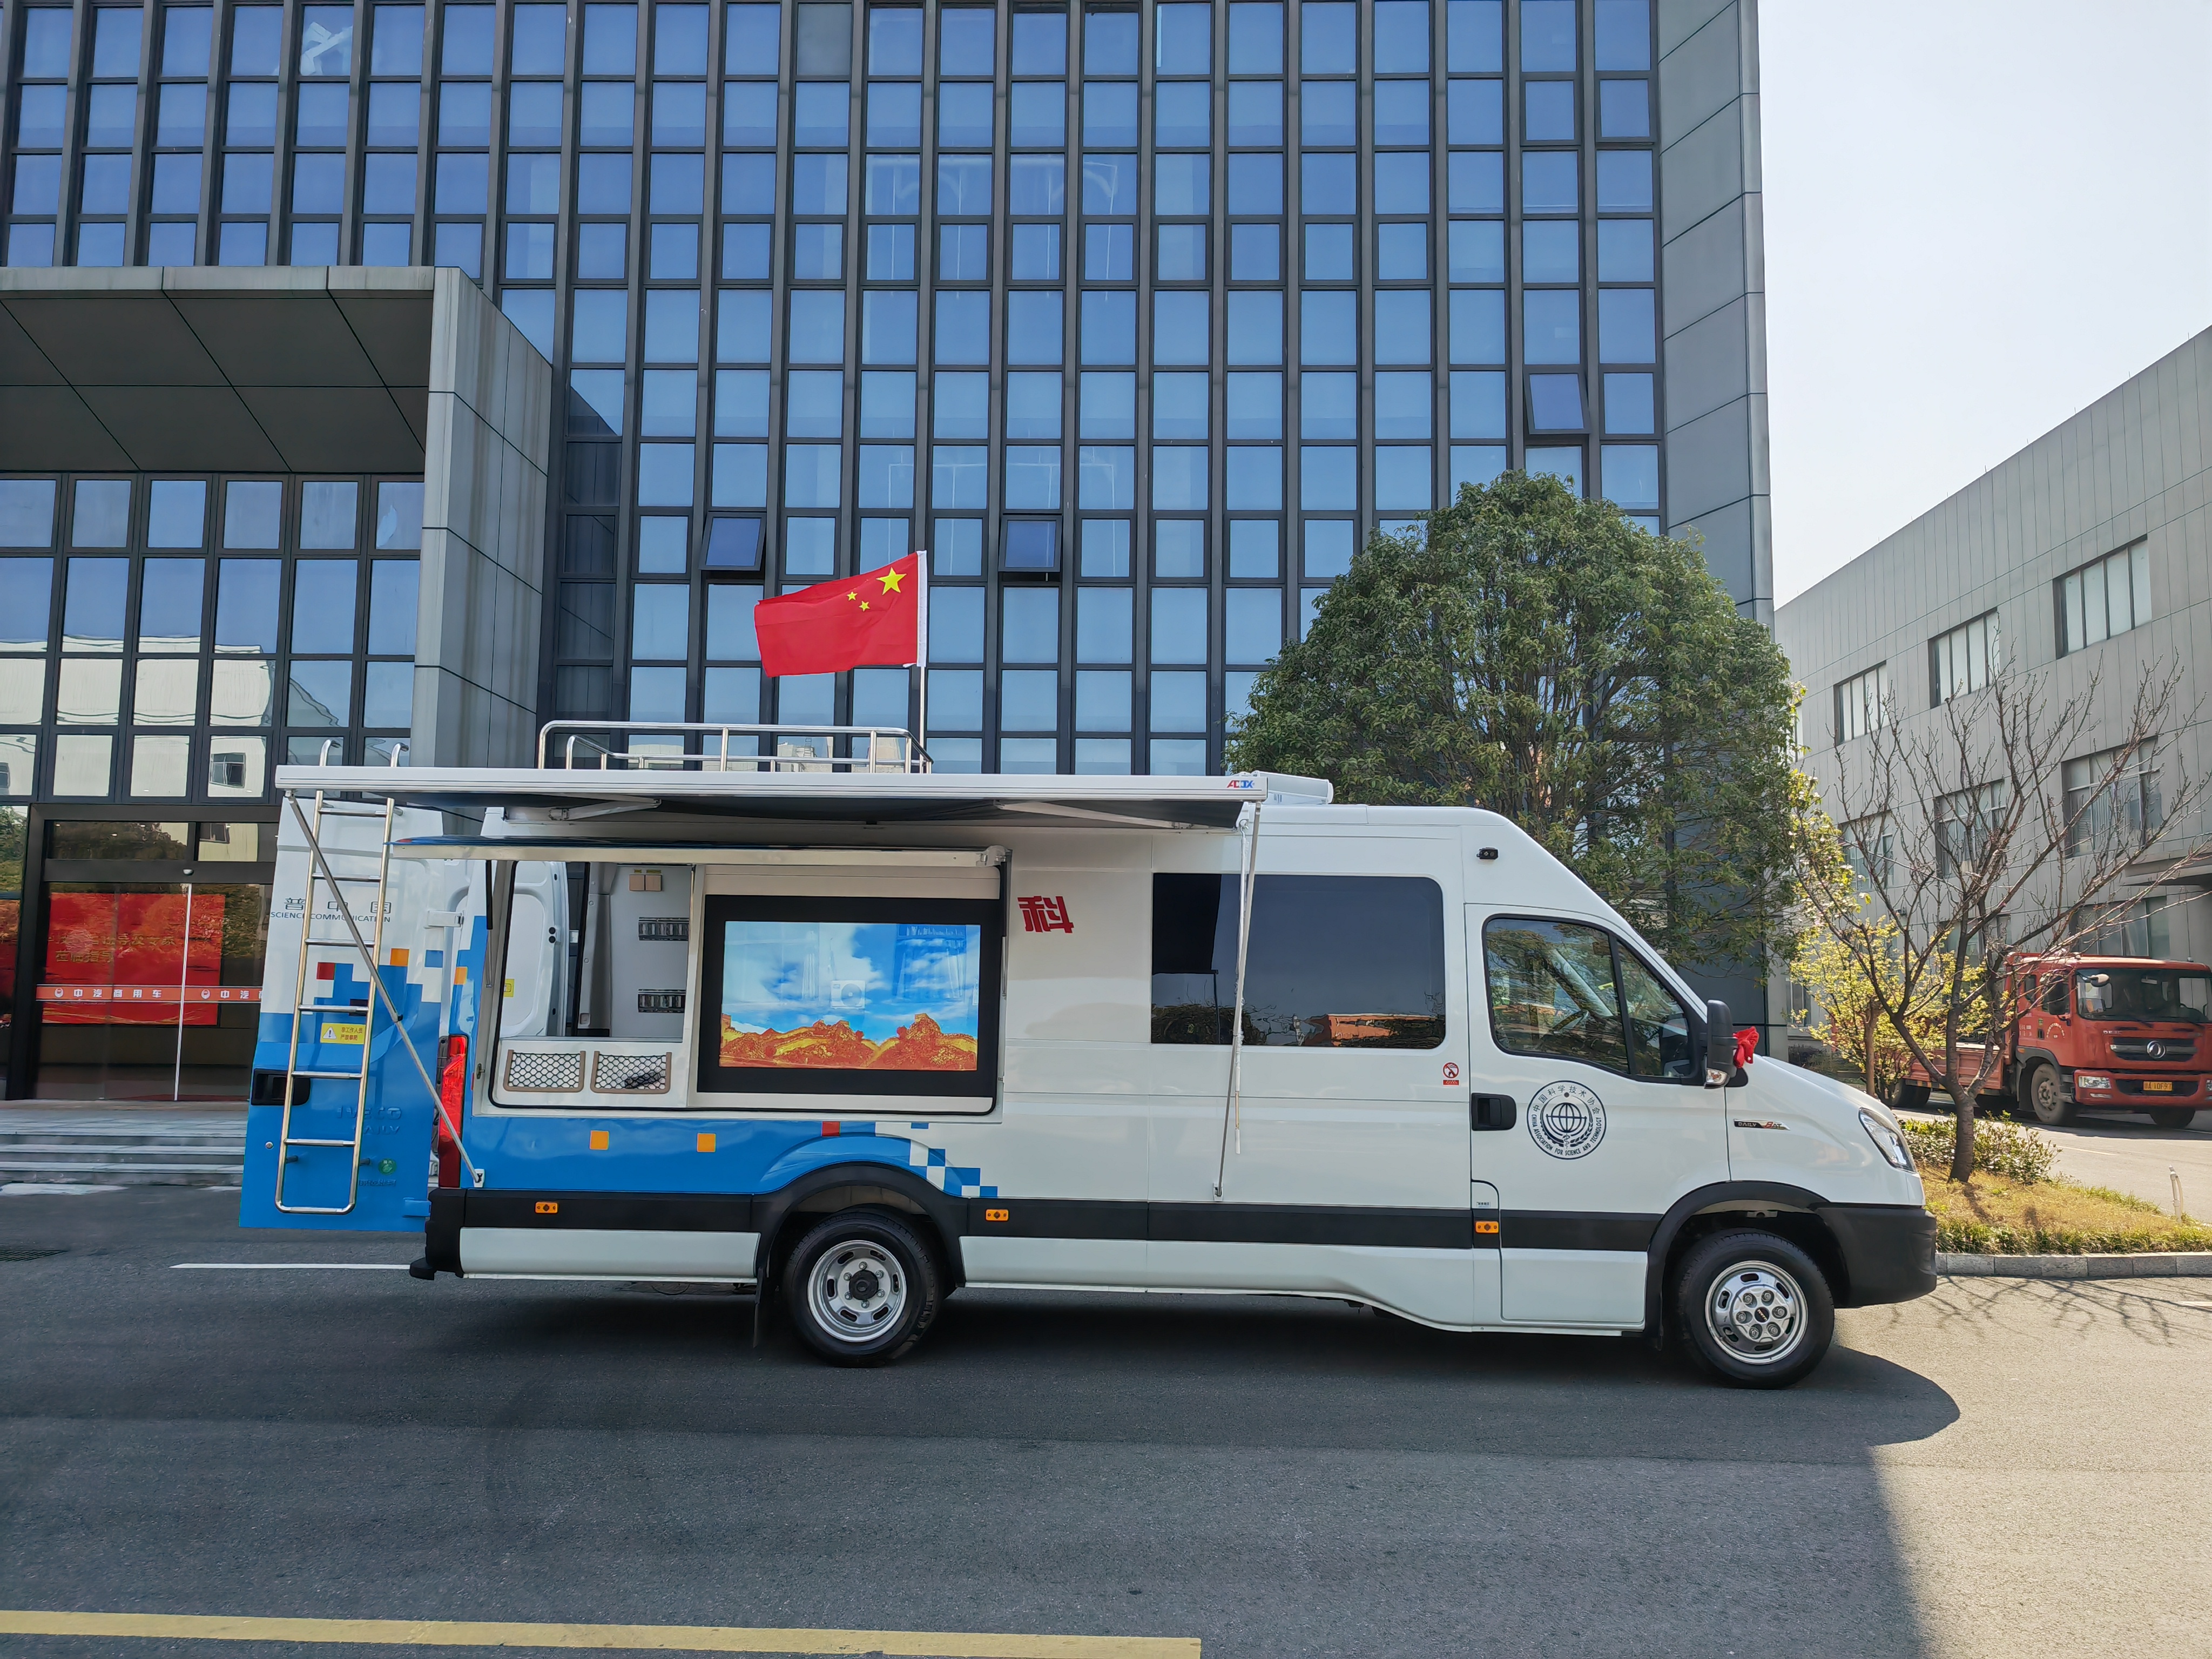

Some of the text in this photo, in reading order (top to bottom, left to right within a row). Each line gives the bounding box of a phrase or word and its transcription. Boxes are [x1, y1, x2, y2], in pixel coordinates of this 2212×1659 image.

[1017, 895, 1074, 934] 科
[73, 989, 162, 999] 中汽商用车
[1533, 1084, 1601, 1115] 中国科学技术协会
[354, 1125, 400, 1135] AILY
[1533, 1128, 1554, 1151] ASSOCIATION
[1583, 1142, 1591, 1151] AND
[1589, 1117, 1602, 1144] TECHNOLOGY
